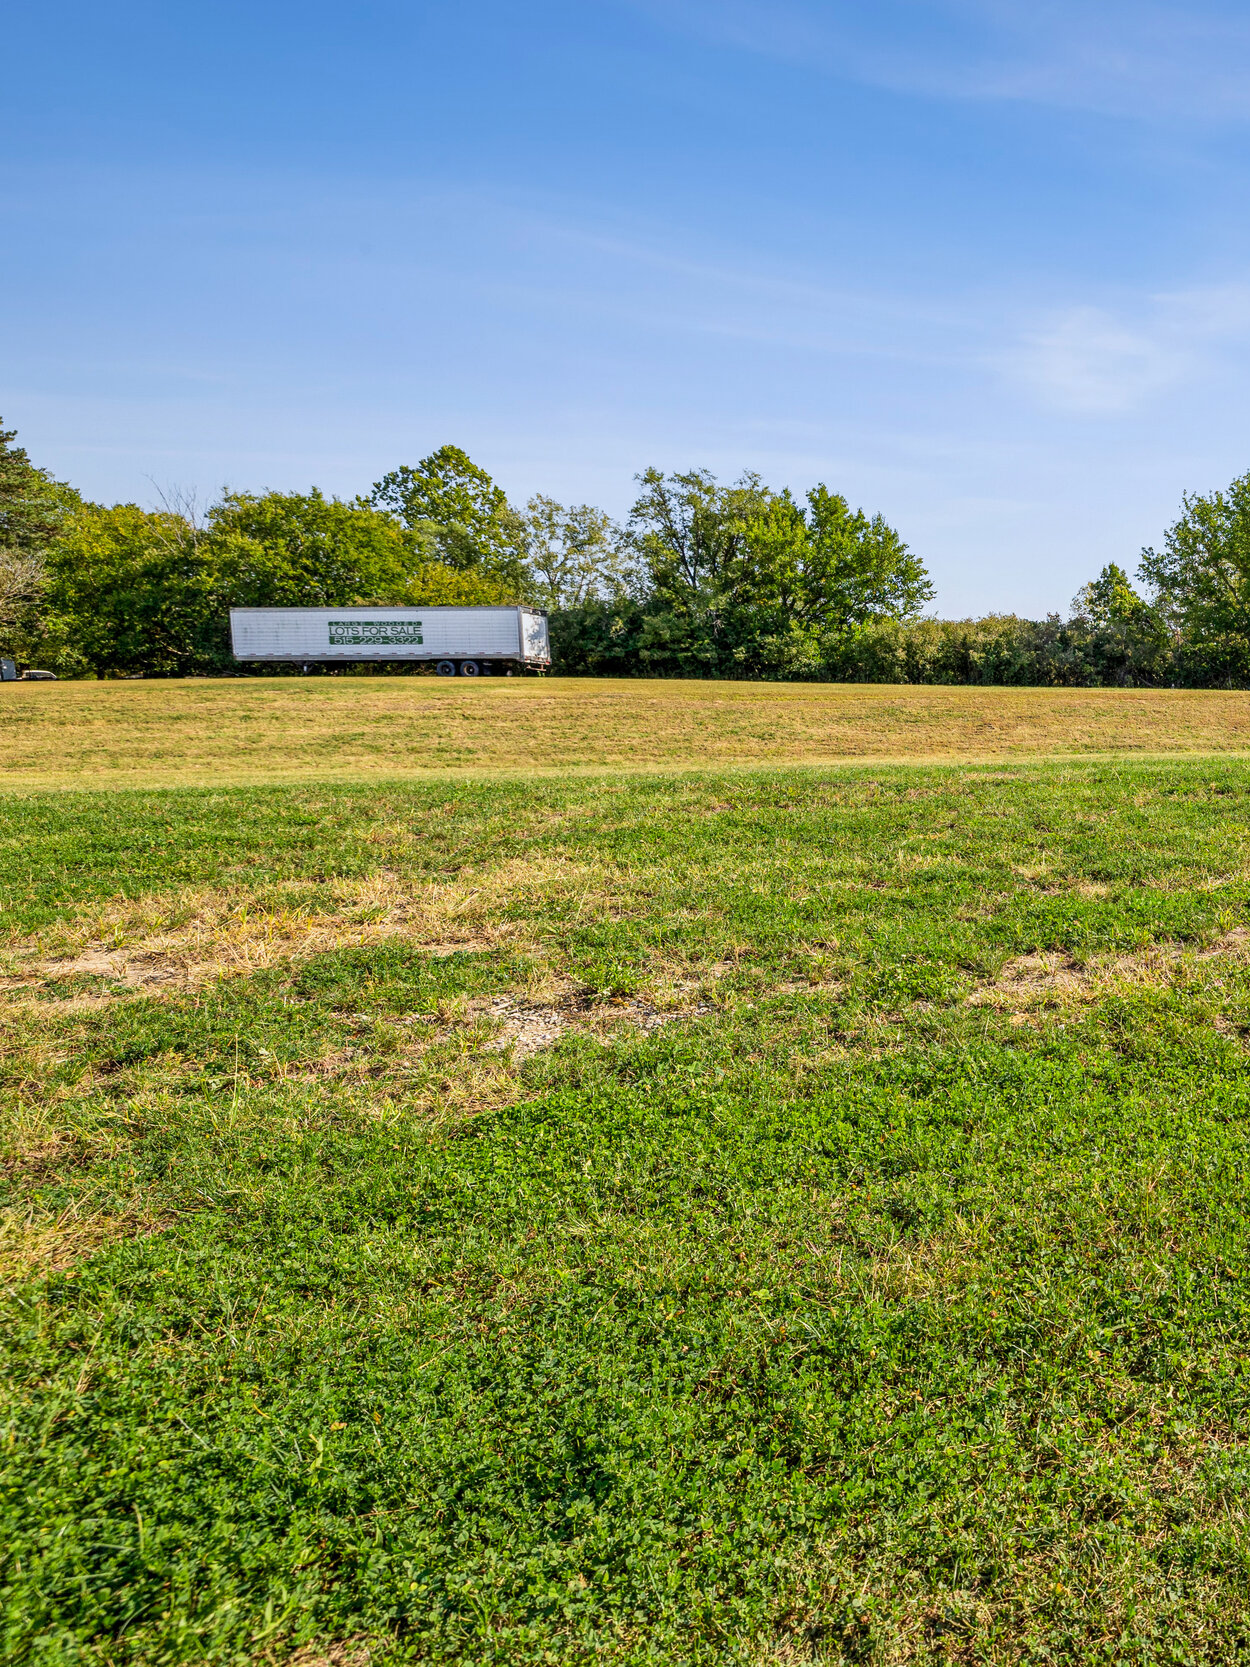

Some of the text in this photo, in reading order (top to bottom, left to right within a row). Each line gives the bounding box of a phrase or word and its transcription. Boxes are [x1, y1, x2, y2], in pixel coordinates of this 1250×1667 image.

[329, 626, 422, 635] LOTS FOR SALE
[333, 636, 419, 645] 515-229-3322
